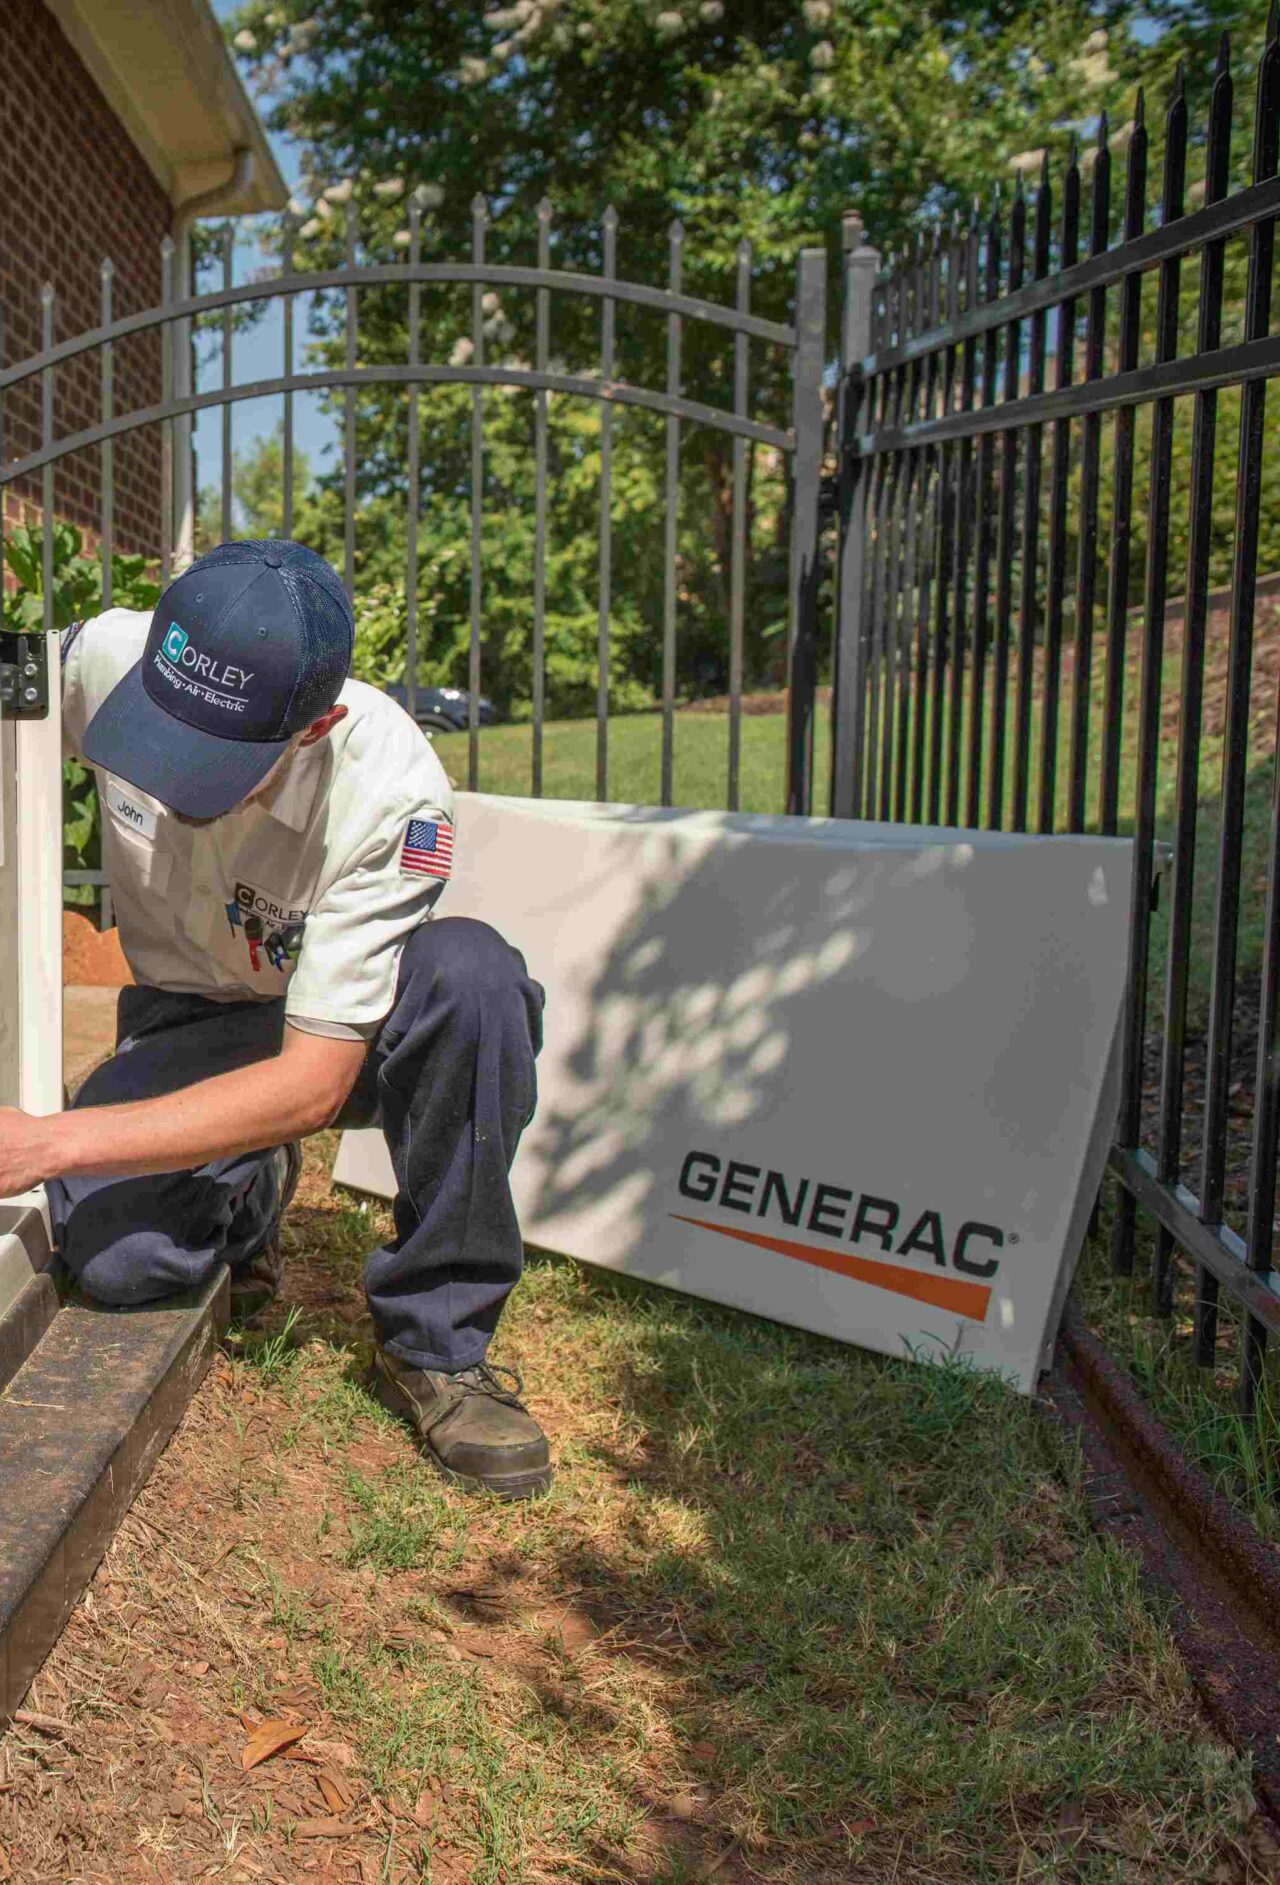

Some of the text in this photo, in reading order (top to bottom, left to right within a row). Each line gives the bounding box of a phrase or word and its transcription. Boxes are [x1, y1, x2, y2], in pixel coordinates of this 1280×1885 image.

[163, 624, 255, 690] CORLEY
[204, 691, 246, 713] Electric
[117, 801, 143, 826] John
